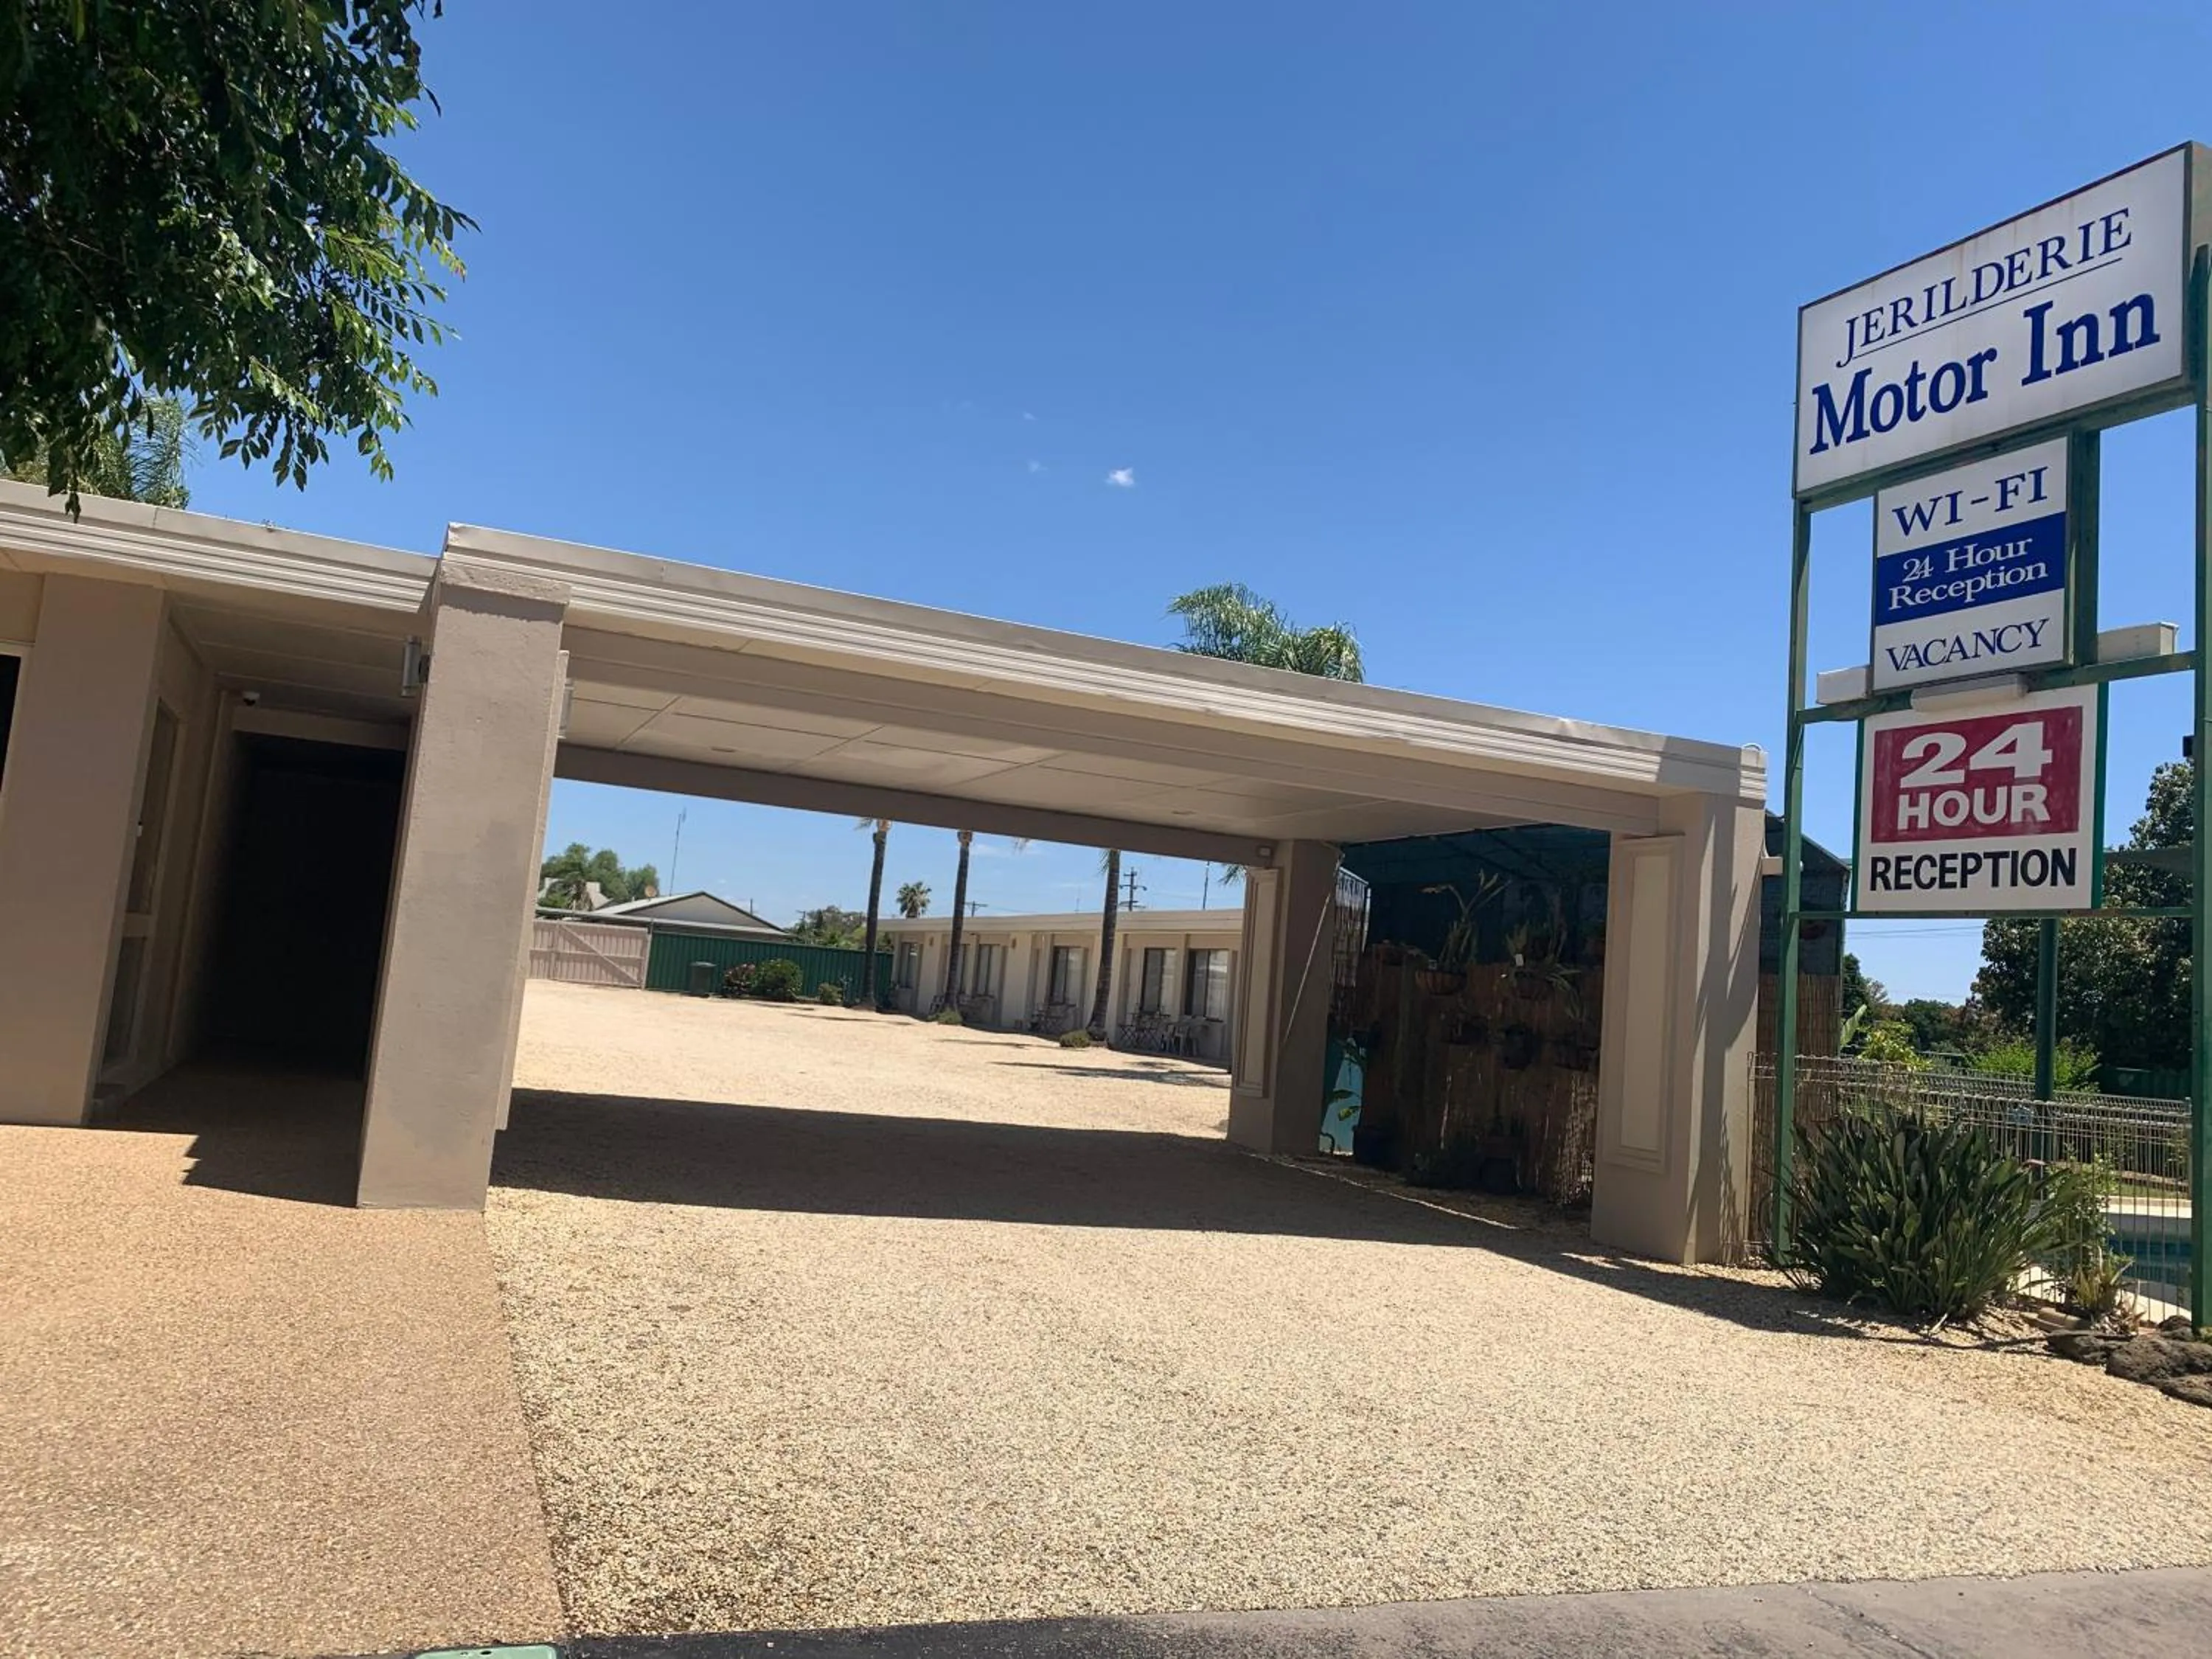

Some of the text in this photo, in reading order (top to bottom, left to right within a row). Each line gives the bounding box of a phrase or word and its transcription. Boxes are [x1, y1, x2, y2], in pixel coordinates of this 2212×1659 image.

[1836, 207, 2132, 367] JERILDERIE
[1809, 293, 2160, 455] Motor Inn
[1892, 467, 2048, 536] WI-FI
[1889, 562, 2048, 611] Reception
[1902, 538, 2032, 582] 24 Hour
[1886, 618, 2050, 672] VACANCY
[1899, 722, 2052, 788] 24
[1897, 785, 2050, 830] HOUR
[1869, 847, 2076, 891] RECEPTION
